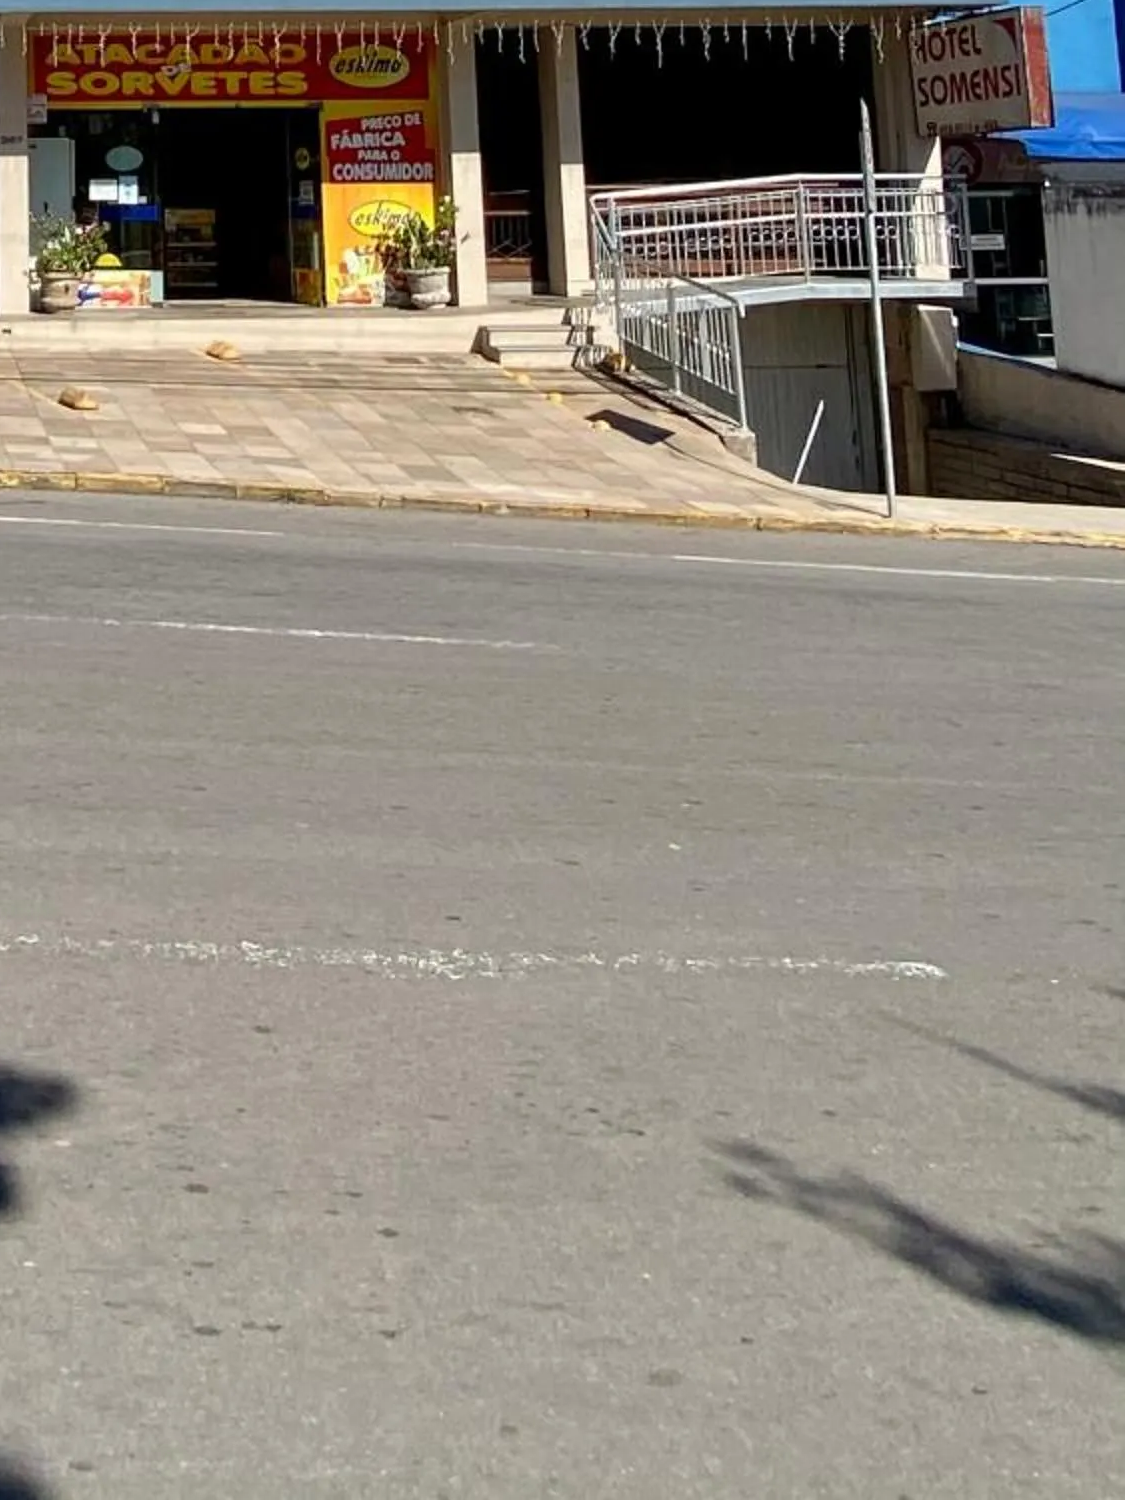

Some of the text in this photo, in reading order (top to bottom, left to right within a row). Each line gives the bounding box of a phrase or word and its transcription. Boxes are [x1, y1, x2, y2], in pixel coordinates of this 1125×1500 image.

[45, 38, 307, 66] ATACADÃO
[914, 25, 981, 64] HOTEL
[334, 43, 403, 74] eskimo
[46, 71, 308, 96] SORVETES
[917, 63, 1022, 108] SOMENSI
[361, 112, 423, 132] PREÇO DE
[330, 129, 406, 150] FÁBRICA
[358, 149, 401, 162] PARA O
[332, 163, 434, 182] CONSUMIDOR
